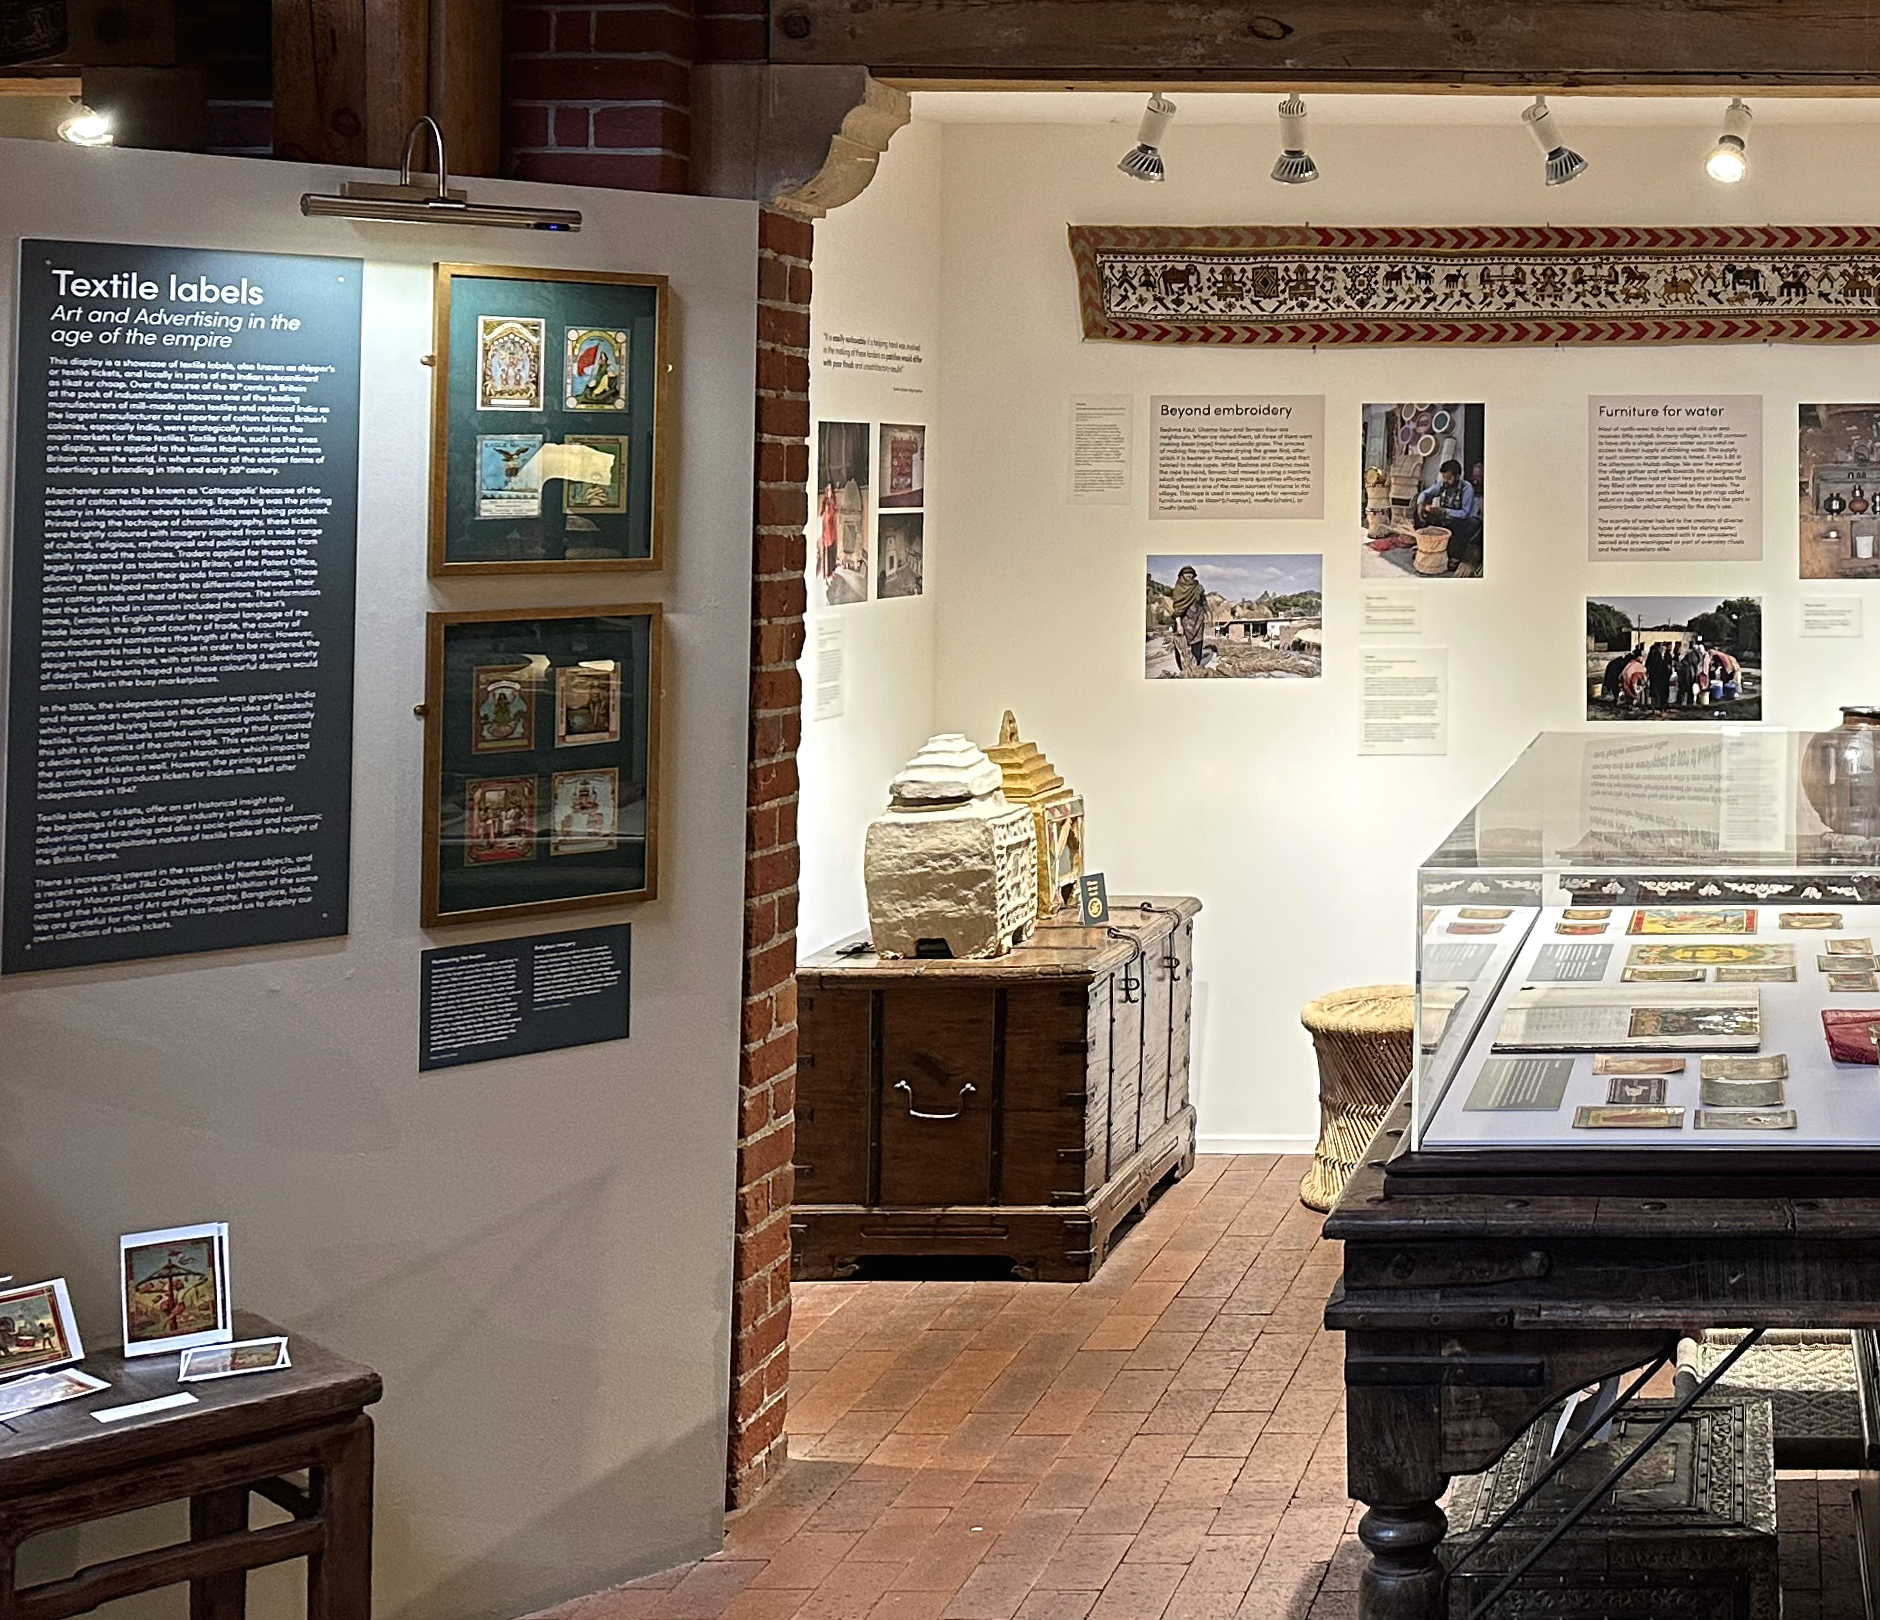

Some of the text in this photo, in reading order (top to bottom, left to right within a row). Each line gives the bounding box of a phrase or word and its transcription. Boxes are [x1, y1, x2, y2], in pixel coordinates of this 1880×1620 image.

[52, 270, 264, 305] Textile labels
[50, 304, 300, 332] Art and Advertising in the
[51, 327, 232, 351] age of the empire
[70, 358, 102, 367] display
[123, 359, 166, 367] showcase
[144, 370, 172, 379] locally
[185, 371, 207, 380] parts
[1161, 404, 1292, 419] Beyond embroidery
[1600, 405, 1724, 417] Furniture for water
[123, 444, 157, 453] applied
[261, 445, 299, 454] exported
[46, 466, 97, 474] advertising
[112, 466, 153, 474] branding
[205, 466, 227, 474] early
[70, 530, 104, 539] brightly
[107, 529, 147, 537] coloured
[170, 529, 206, 537] imagery
[209, 528, 242, 537] inspired
